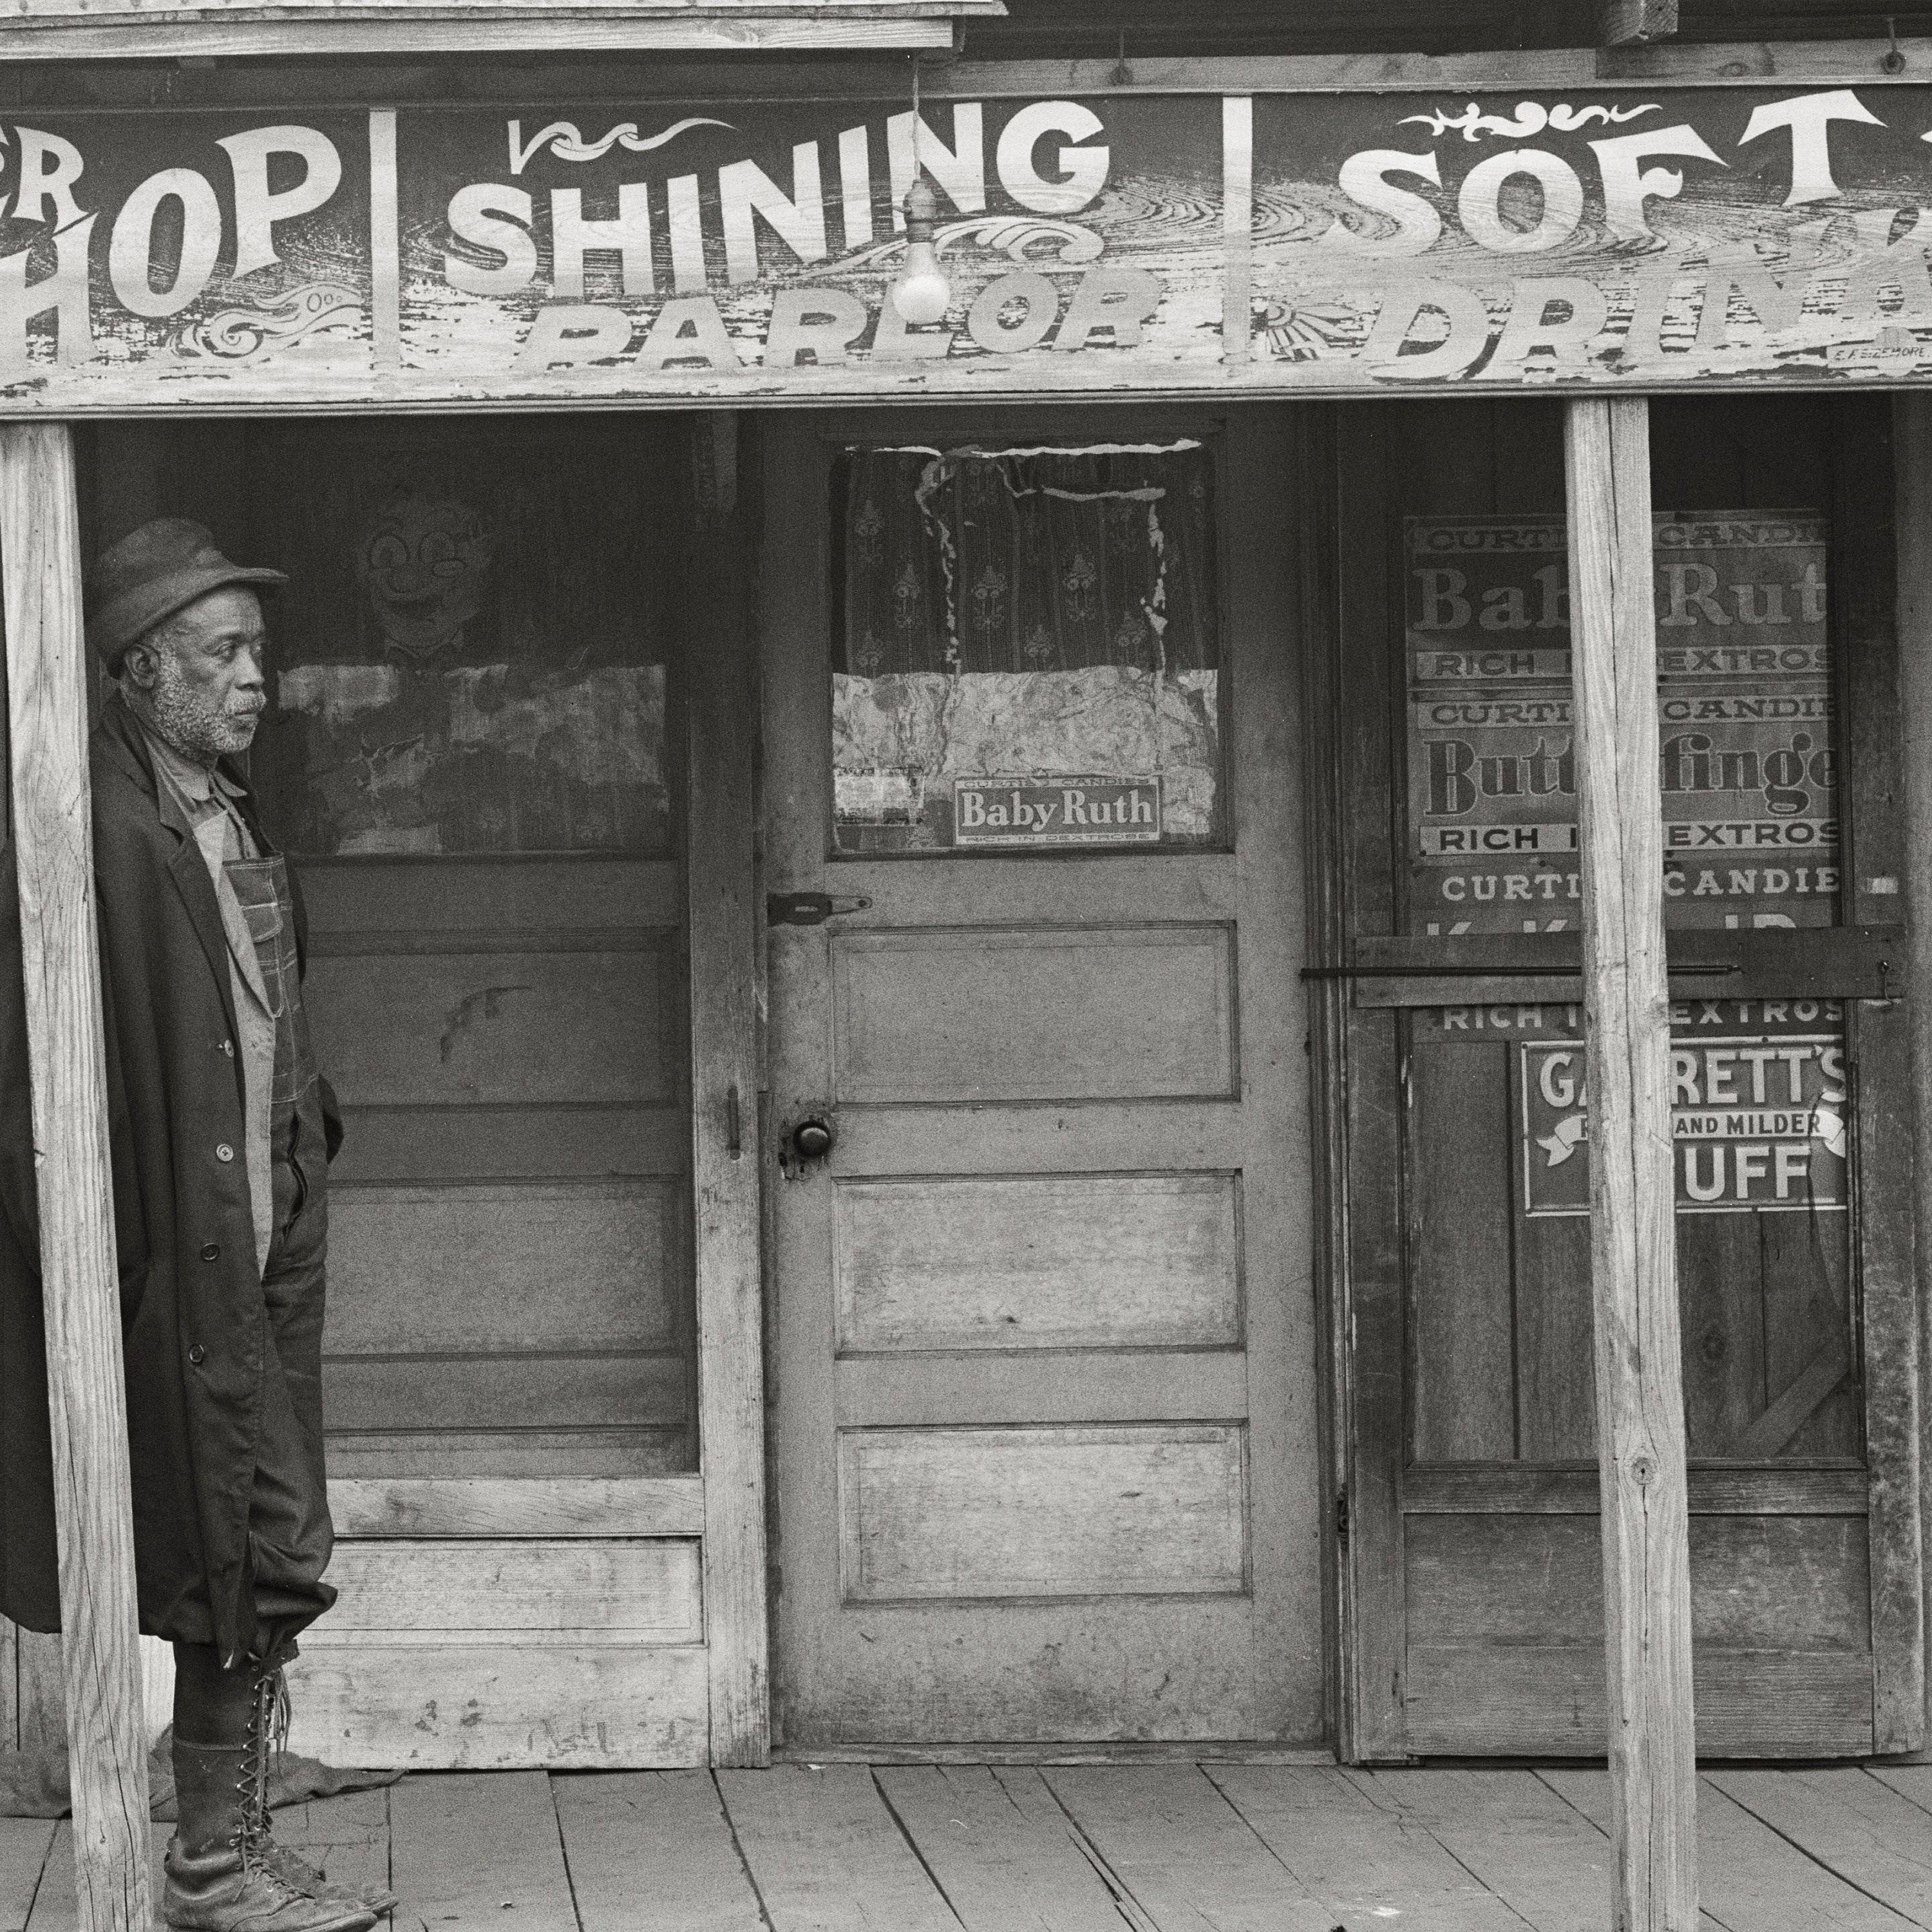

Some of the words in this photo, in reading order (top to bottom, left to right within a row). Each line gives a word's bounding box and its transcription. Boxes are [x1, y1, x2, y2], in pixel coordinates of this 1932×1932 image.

[0, 124, 84, 236] R
[1328, 89, 1888, 257] SOFT
[445, 100, 1110, 298] SHINING
[512, 265, 1160, 370] PARLOR
[1427, 529, 1567, 550] CURTI
[1412, 564, 1571, 632] Bab
[1659, 562, 1827, 627] Rut
[1435, 652, 1535, 676] RICH
[1658, 648, 1831, 672] EXTROS
[1431, 703, 1571, 724] CURTI
[1663, 697, 1835, 720] CANDIE
[961, 790, 1058, 832] Baby
[1062, 788, 1154, 825] Ruth
[1440, 828, 1538, 851] RICH
[1668, 821, 1839, 846] EXTROS
[1442, 873, 1580, 901] CURTI
[1663, 867, 1839, 896] CANDIE
[1443, 1005, 1542, 1030] RICH
[1669, 1001, 1843, 1025] EXTROS
[1540, 1044, 1846, 1108] GRETT'S
[1675, 1117, 1718, 1133] AND
[1726, 1113, 1821, 1135] MILDER
[1685, 1145, 1812, 1201] UFF
